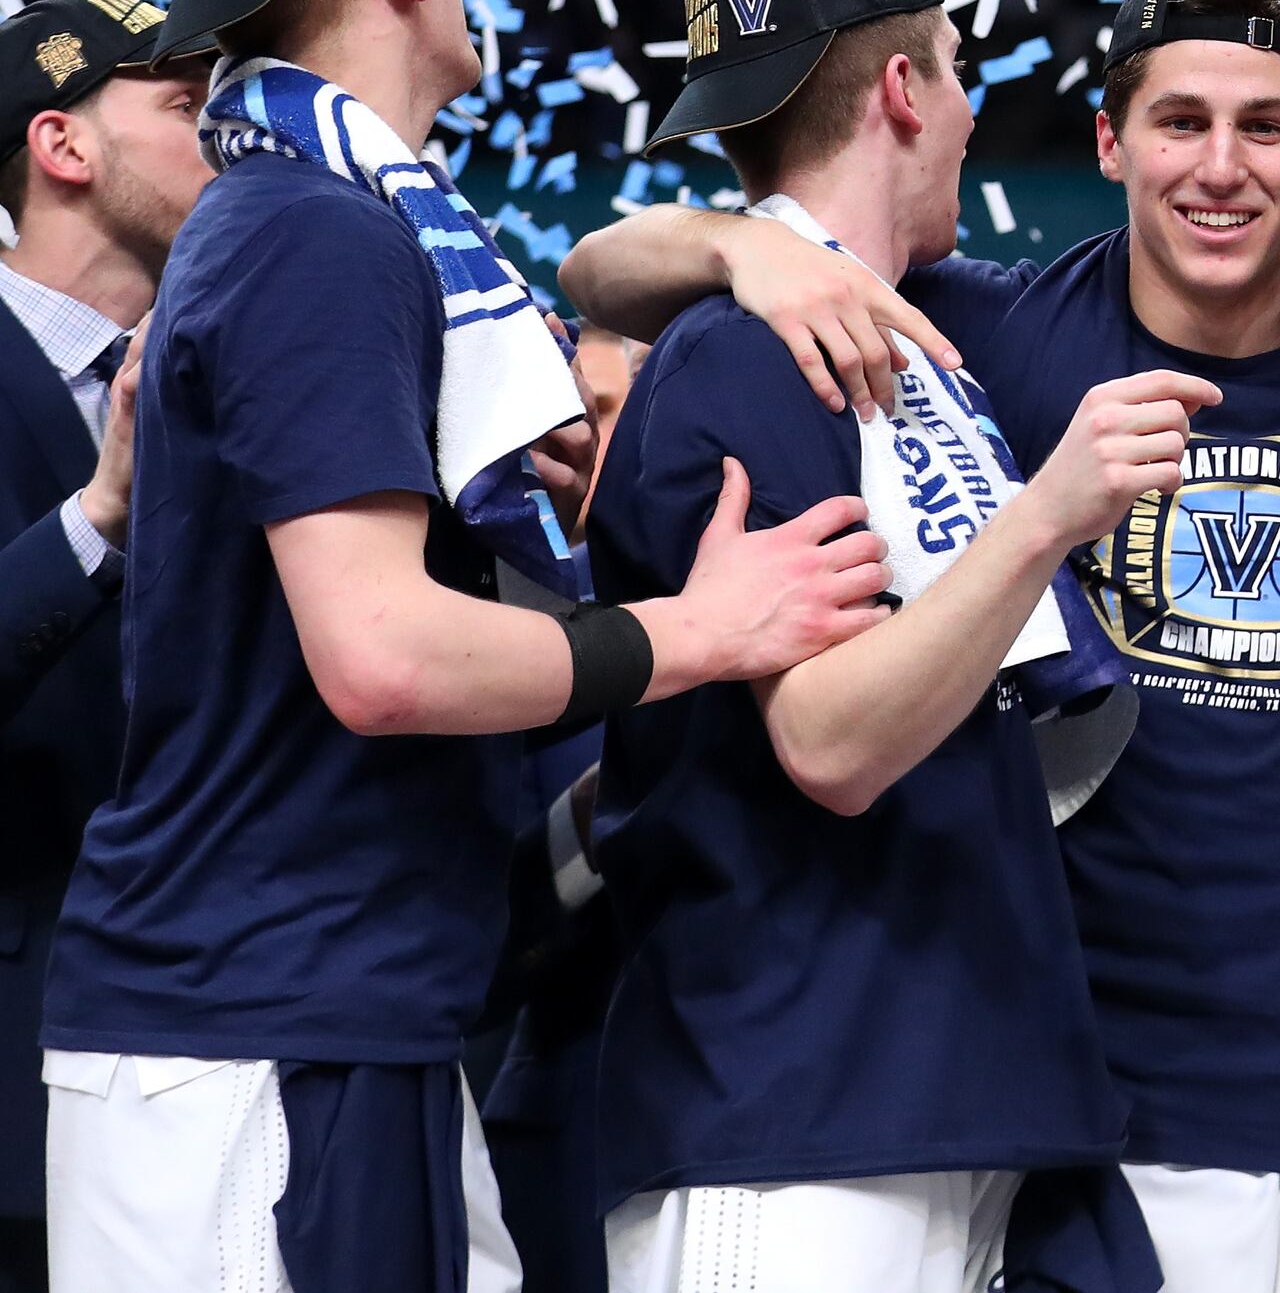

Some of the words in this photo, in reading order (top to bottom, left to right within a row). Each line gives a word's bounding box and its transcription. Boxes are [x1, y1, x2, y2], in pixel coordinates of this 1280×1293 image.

[1214, 682, 1280, 698] BASKETBALL
[1182, 692, 1204, 705] SAN
[1266, 699, 1280, 711] TX
